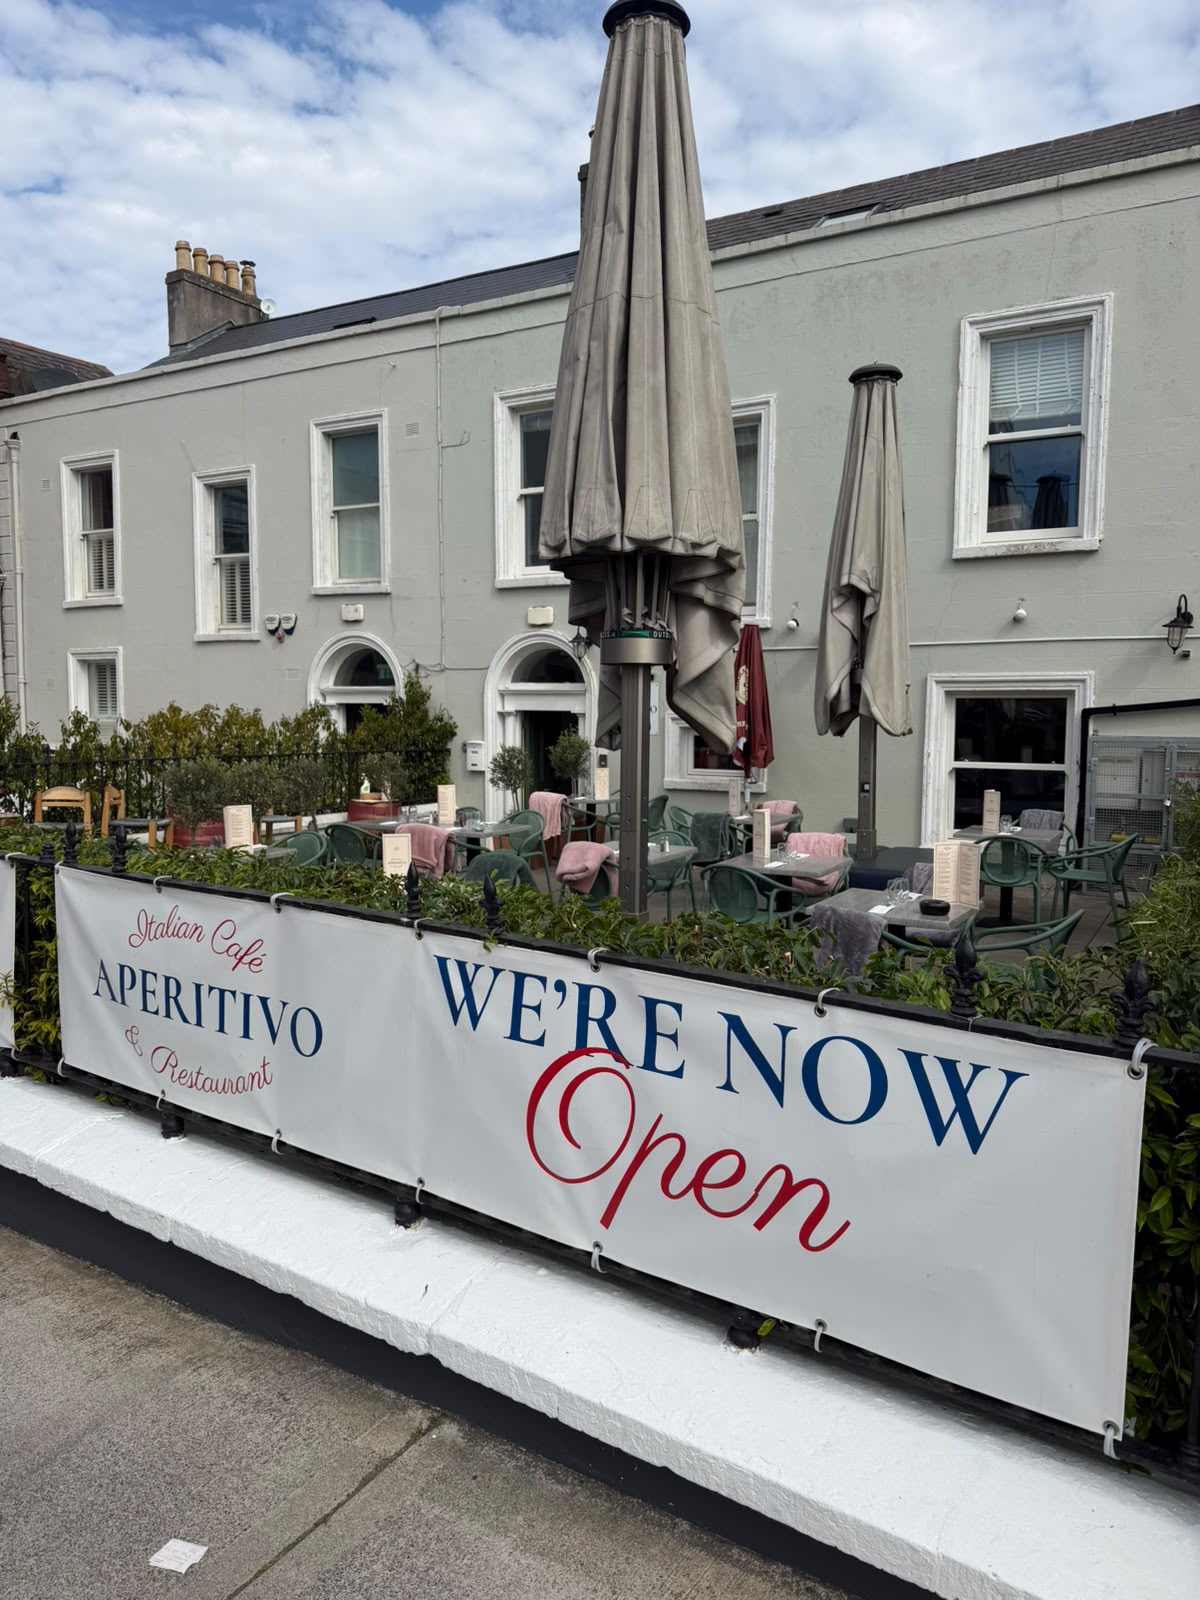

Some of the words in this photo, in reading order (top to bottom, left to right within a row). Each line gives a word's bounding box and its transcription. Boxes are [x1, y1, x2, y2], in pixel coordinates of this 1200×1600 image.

[128, 905, 205, 948] Italian
[210, 919, 268, 974] Café
[93, 957, 323, 1058] APERITIVO
[433, 955, 686, 1079] WE'RE
[716, 1011, 1029, 1156] NOW
[124, 1025, 144, 1057] &
[151, 1045, 273, 1096] Restaurant
[526, 1046, 851, 1256] Open
